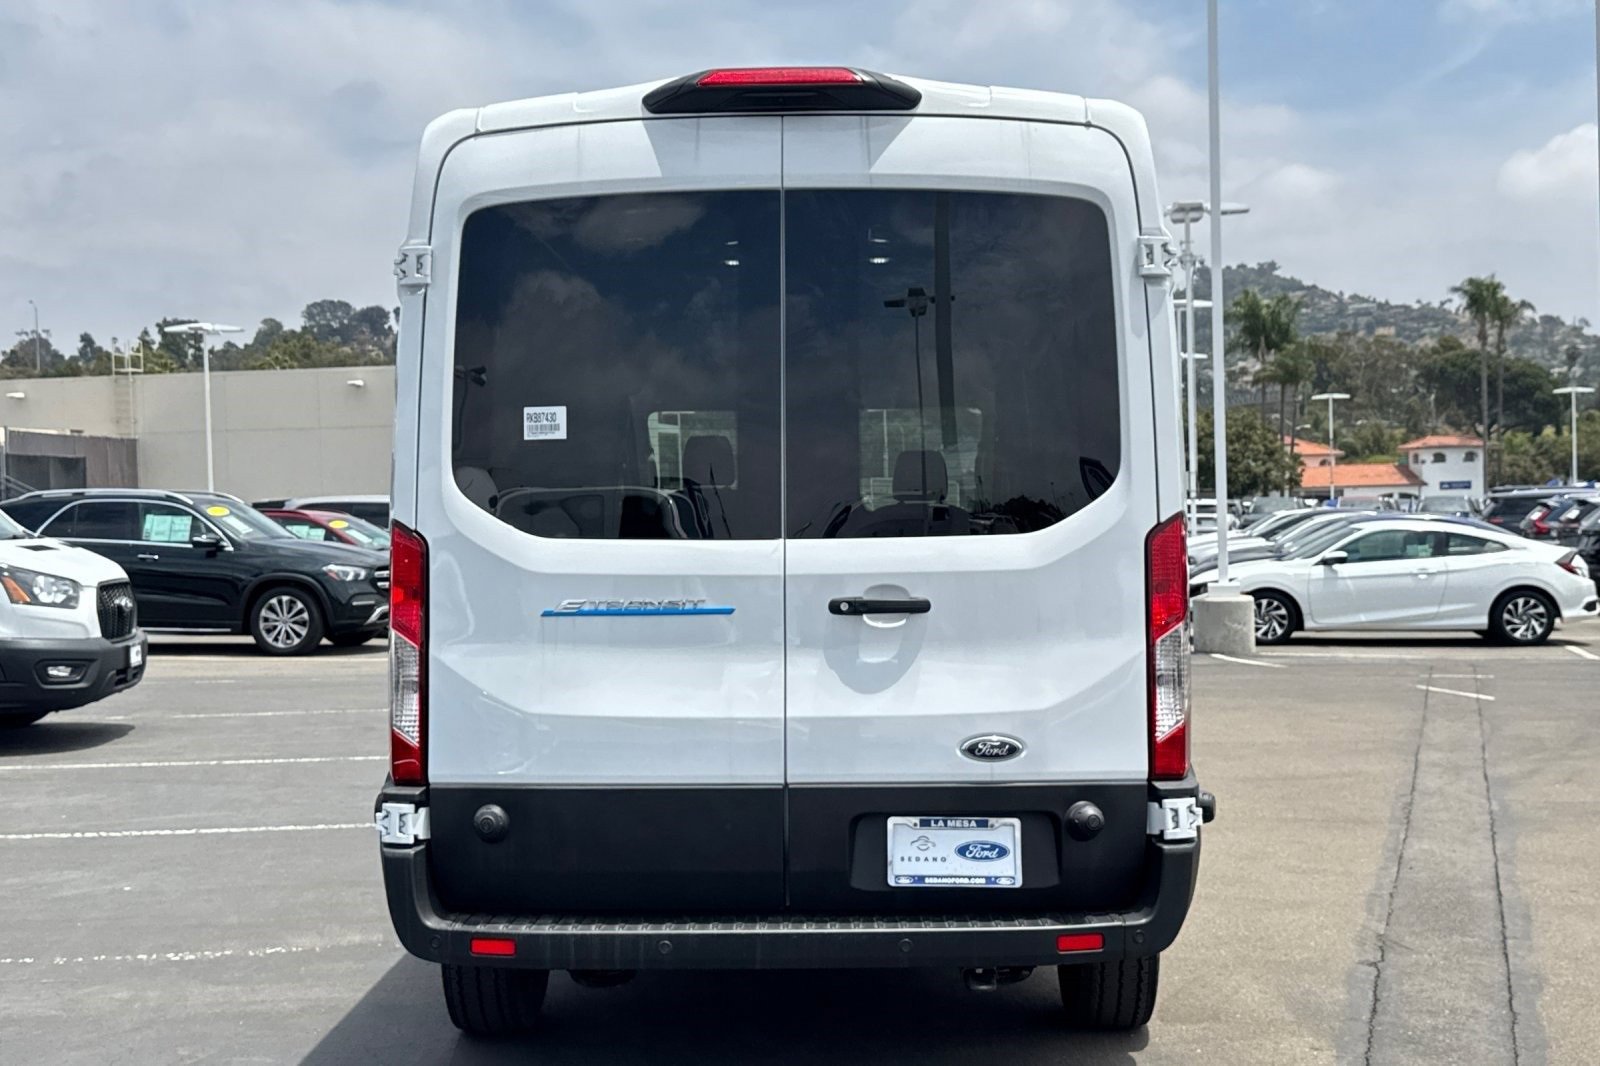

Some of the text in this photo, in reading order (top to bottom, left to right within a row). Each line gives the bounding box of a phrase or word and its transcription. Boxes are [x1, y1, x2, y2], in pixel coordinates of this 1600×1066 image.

[975, 741, 1009, 756] Ford
[931, 819, 977, 828] LA MESA
[965, 843, 998, 859] Ford
